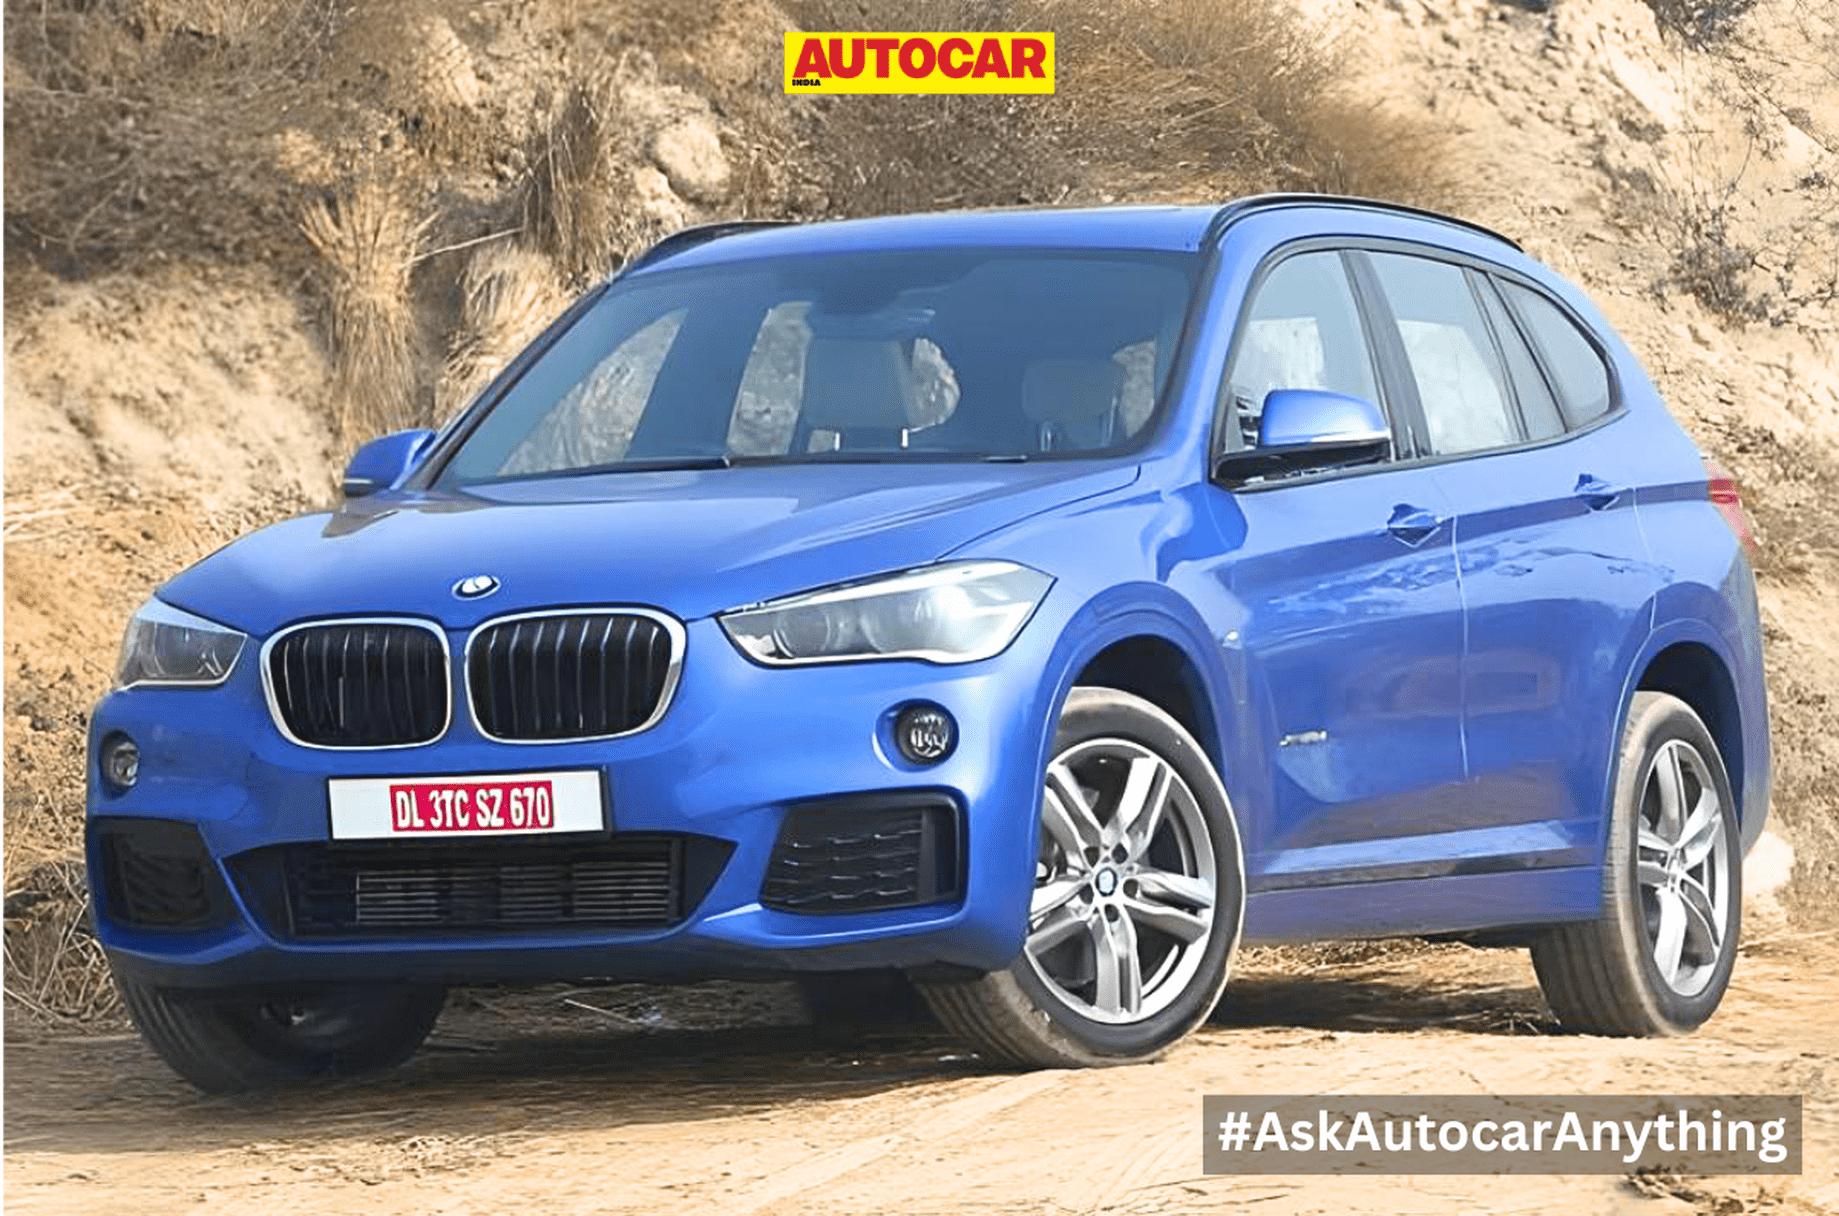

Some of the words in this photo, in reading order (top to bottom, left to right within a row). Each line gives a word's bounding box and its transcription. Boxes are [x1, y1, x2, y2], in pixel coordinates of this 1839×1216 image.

[395, 790, 424, 828] DL
[429, 788, 470, 828] 3TC
[475, 788, 505, 827] SZ
[509, 786, 550, 826] 670
